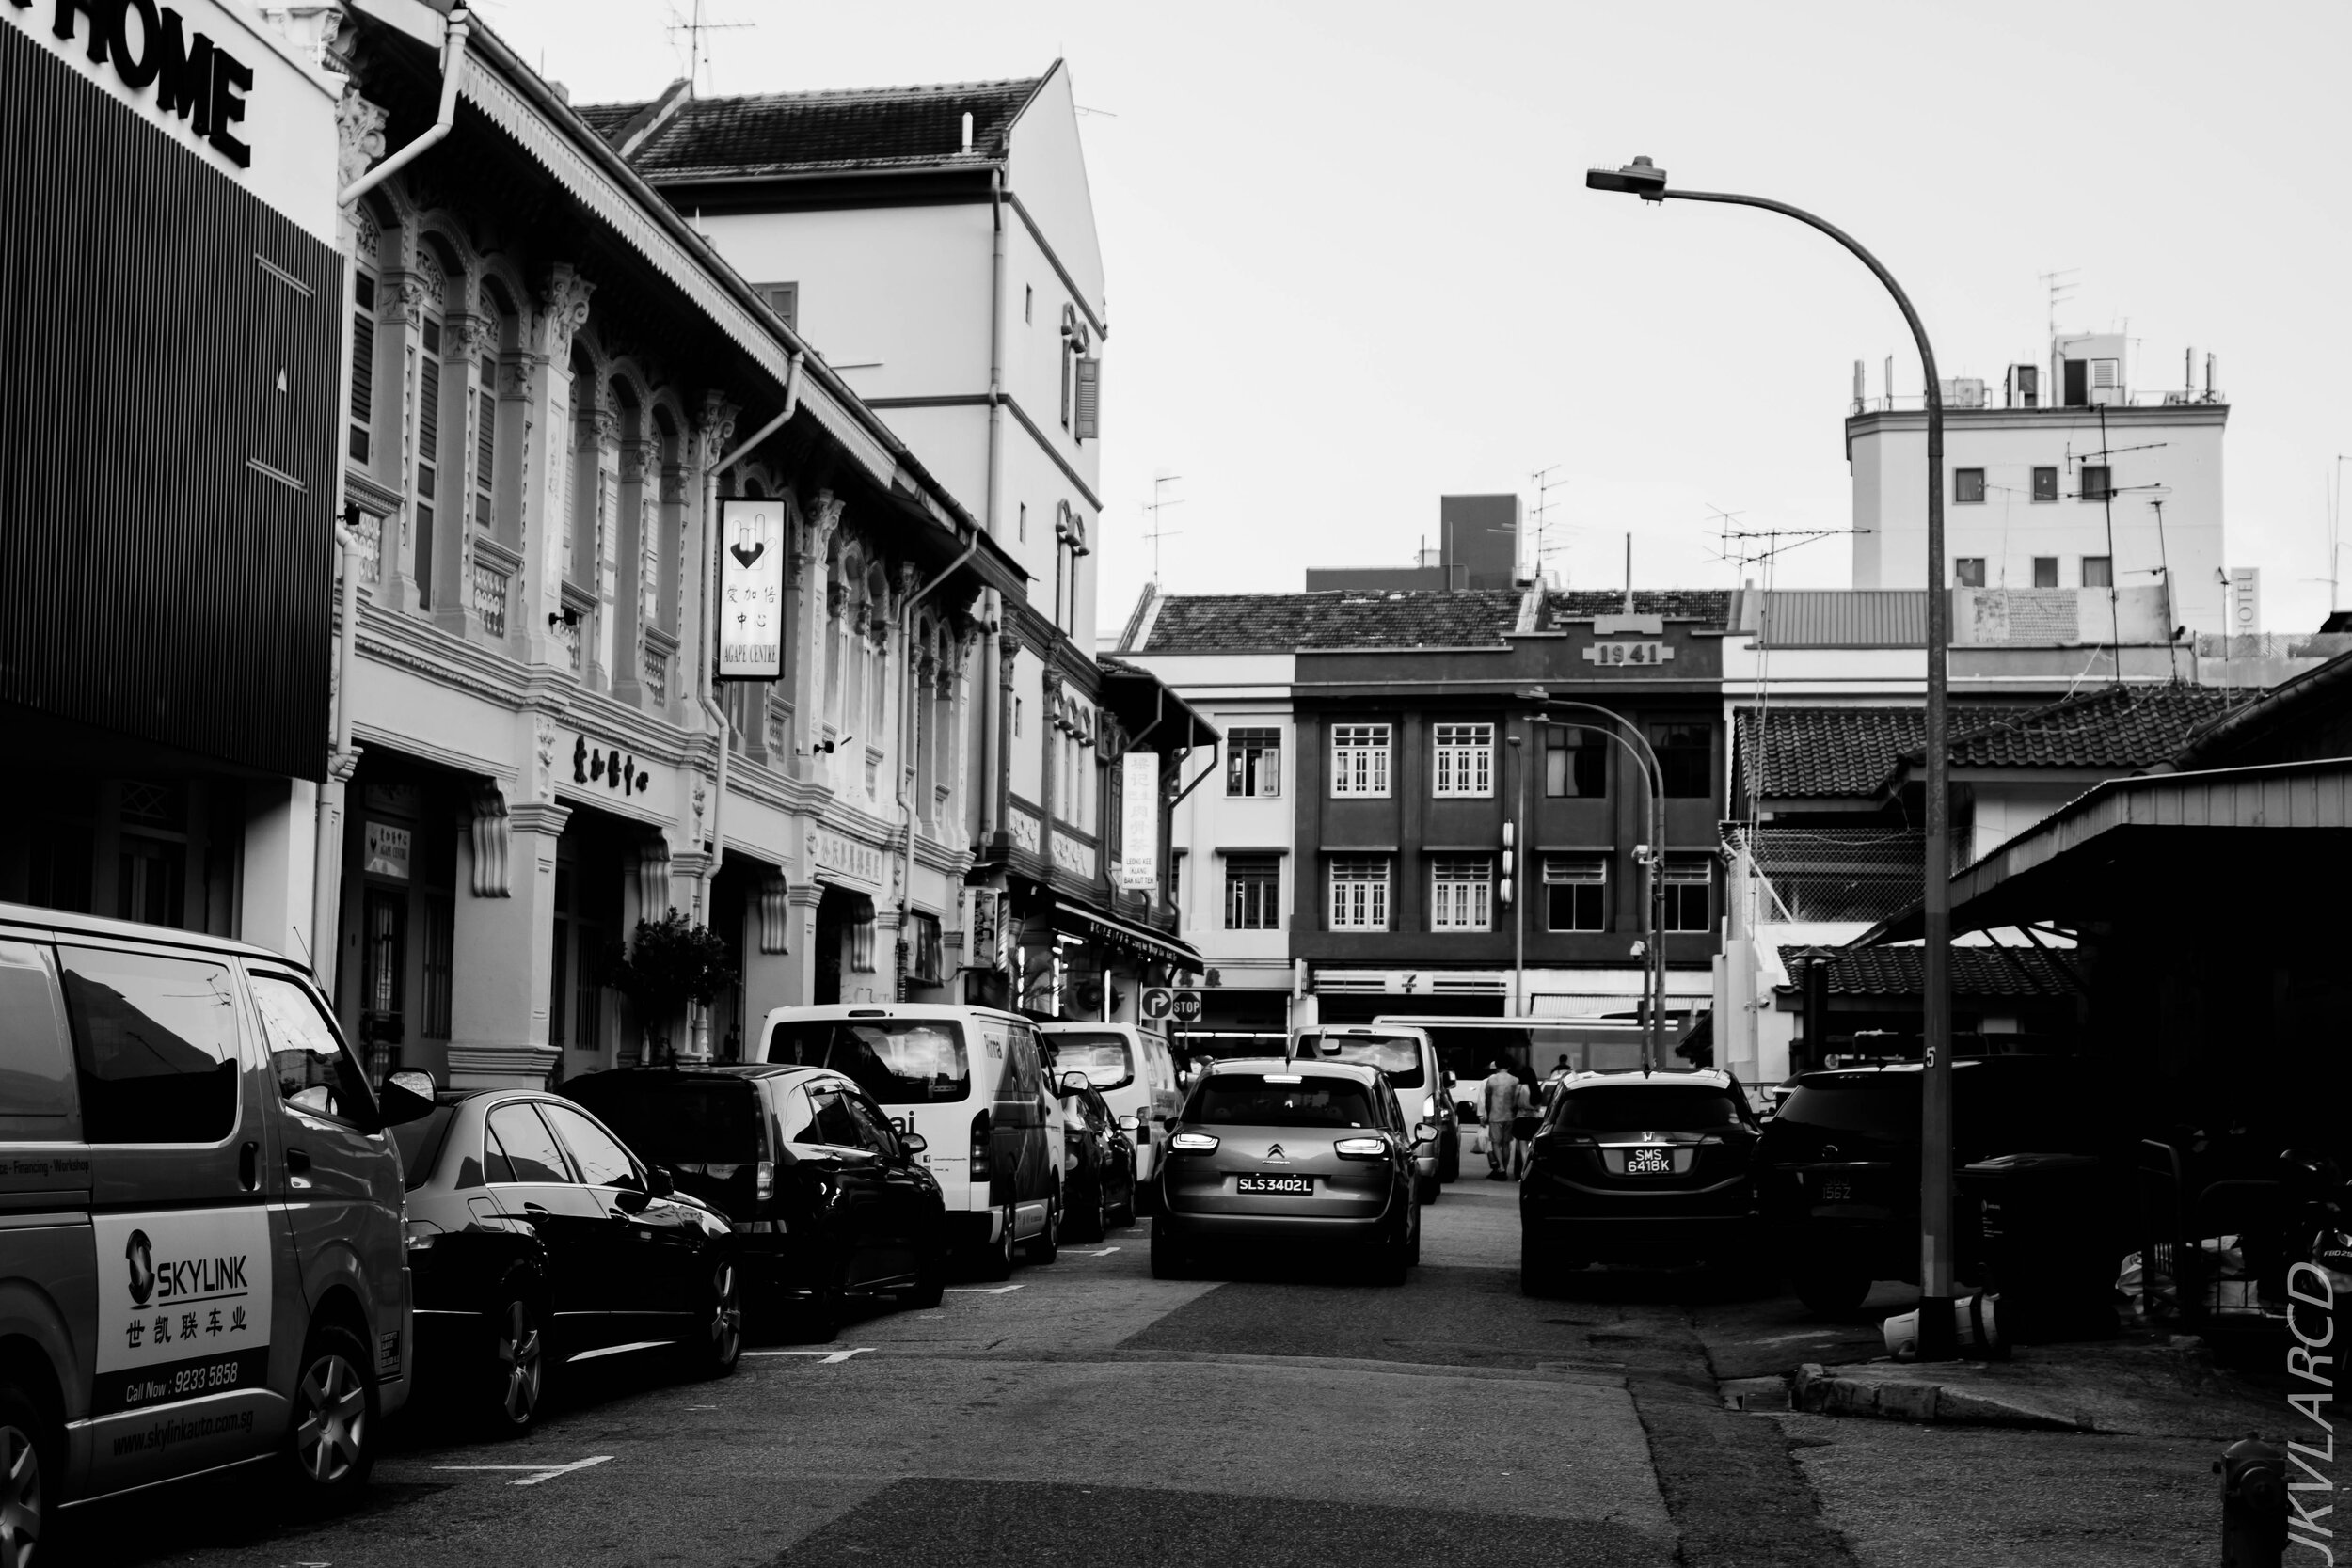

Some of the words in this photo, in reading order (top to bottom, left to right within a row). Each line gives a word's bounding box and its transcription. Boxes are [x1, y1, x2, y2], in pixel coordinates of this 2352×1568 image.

[723, 644, 747, 663] AGAPE
[749, 644, 777, 663] CENTRE
[1600, 644, 1656, 664] 1941
[1123, 876, 1134, 884] BAK
[1134, 876, 1143, 884] KUT
[1173, 1001, 1200, 1013] STOP
[1926, 1046, 1936, 1068] 5
[1635, 1148, 1662, 1161] SMS
[13, 1160, 48, 1177] Financing
[53, 1159, 89, 1174] Workshop
[1628, 1160, 1669, 1172] 6418K
[1239, 1178, 1312, 1192] SLS3402L
[1822, 1186, 1851, 1200] 156Z
[157, 1255, 248, 1298] SKYLINK
[126, 1305, 247, 1349] 世凯联车业
[126, 1382, 144, 1402] Call
[145, 1381, 167, 1399] Now
[174, 1368, 206, 1394] 9233
[208, 1361, 238, 1387] 5858
[113, 1410, 254, 1457] www.skylinkauto.com.sg
